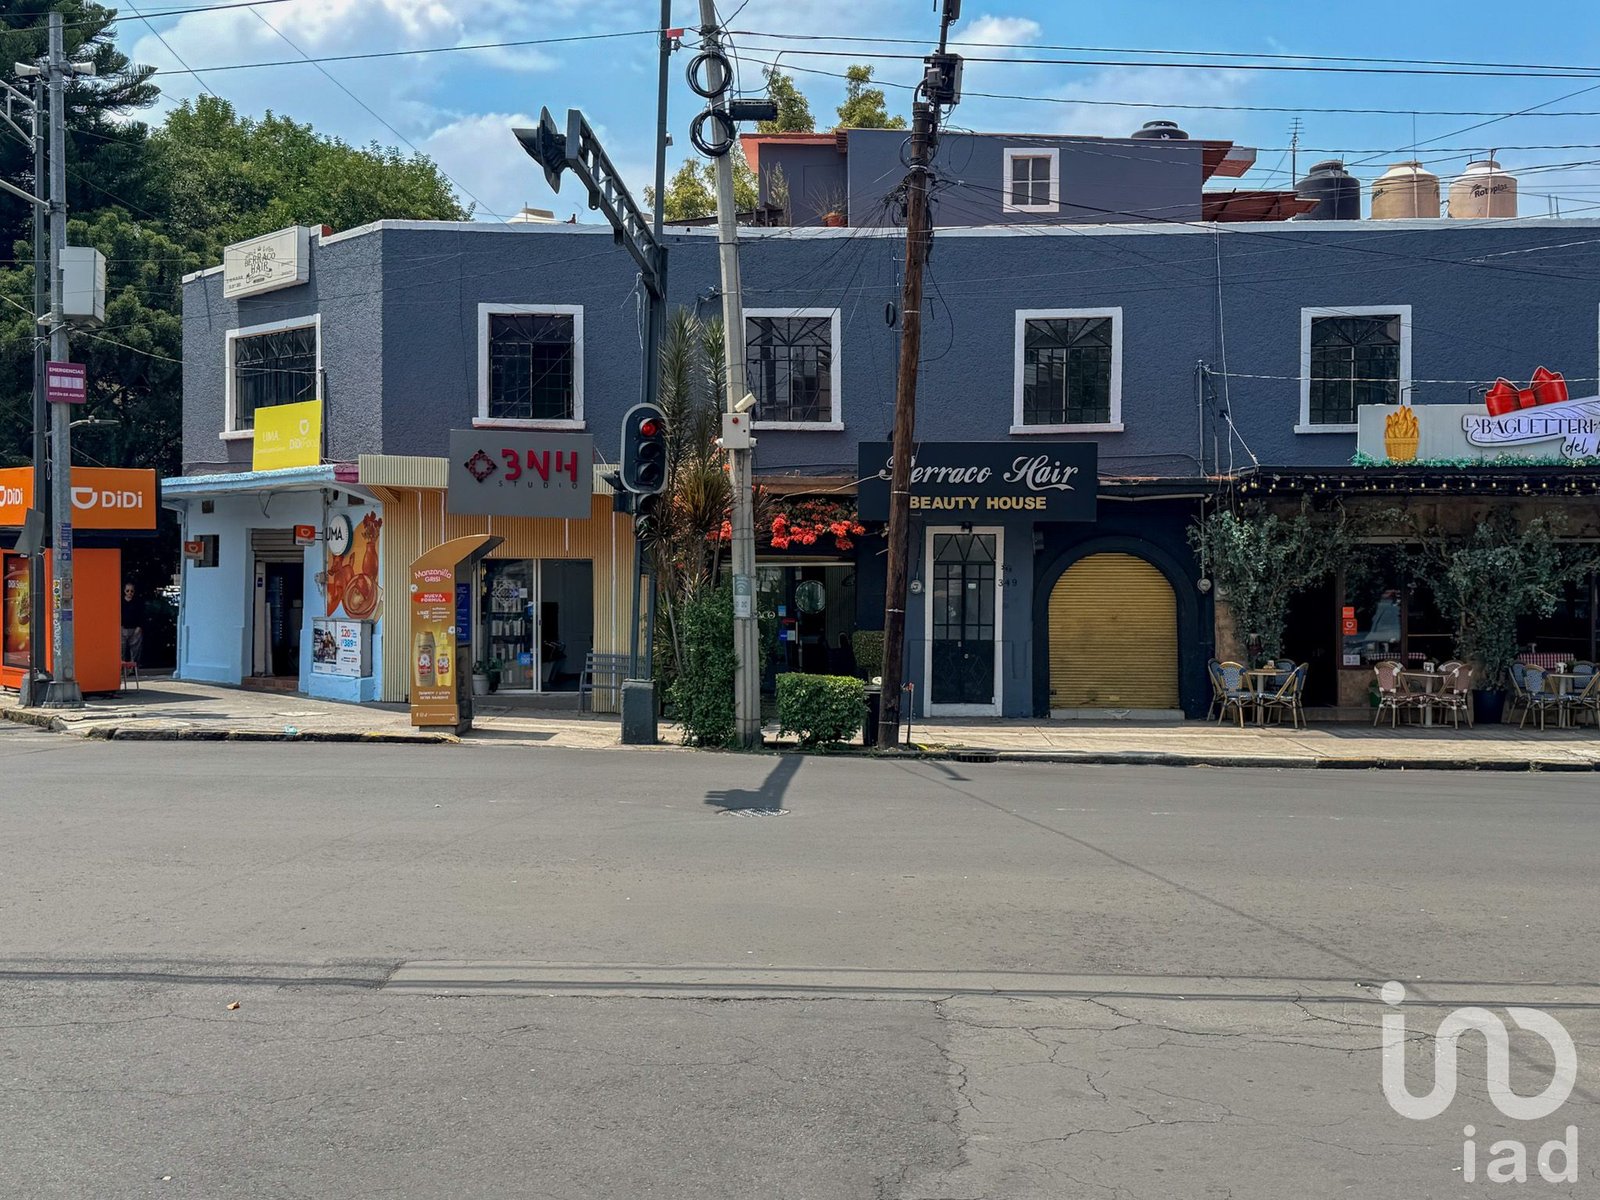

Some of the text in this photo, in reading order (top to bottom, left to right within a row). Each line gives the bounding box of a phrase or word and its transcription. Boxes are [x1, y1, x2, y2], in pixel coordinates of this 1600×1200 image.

[49, 367, 84, 375] EMERGENCIAS
[1565, 436, 1589, 456] del
[1003, 454, 1079, 491] Hair
[498, 480, 579, 490] STUDIO
[7, 488, 25, 506] DiDi
[101, 490, 143, 509] DiDi
[909, 496, 1047, 510] BEAUTY HOUSE
[414, 568, 452, 579] Manzanilla
